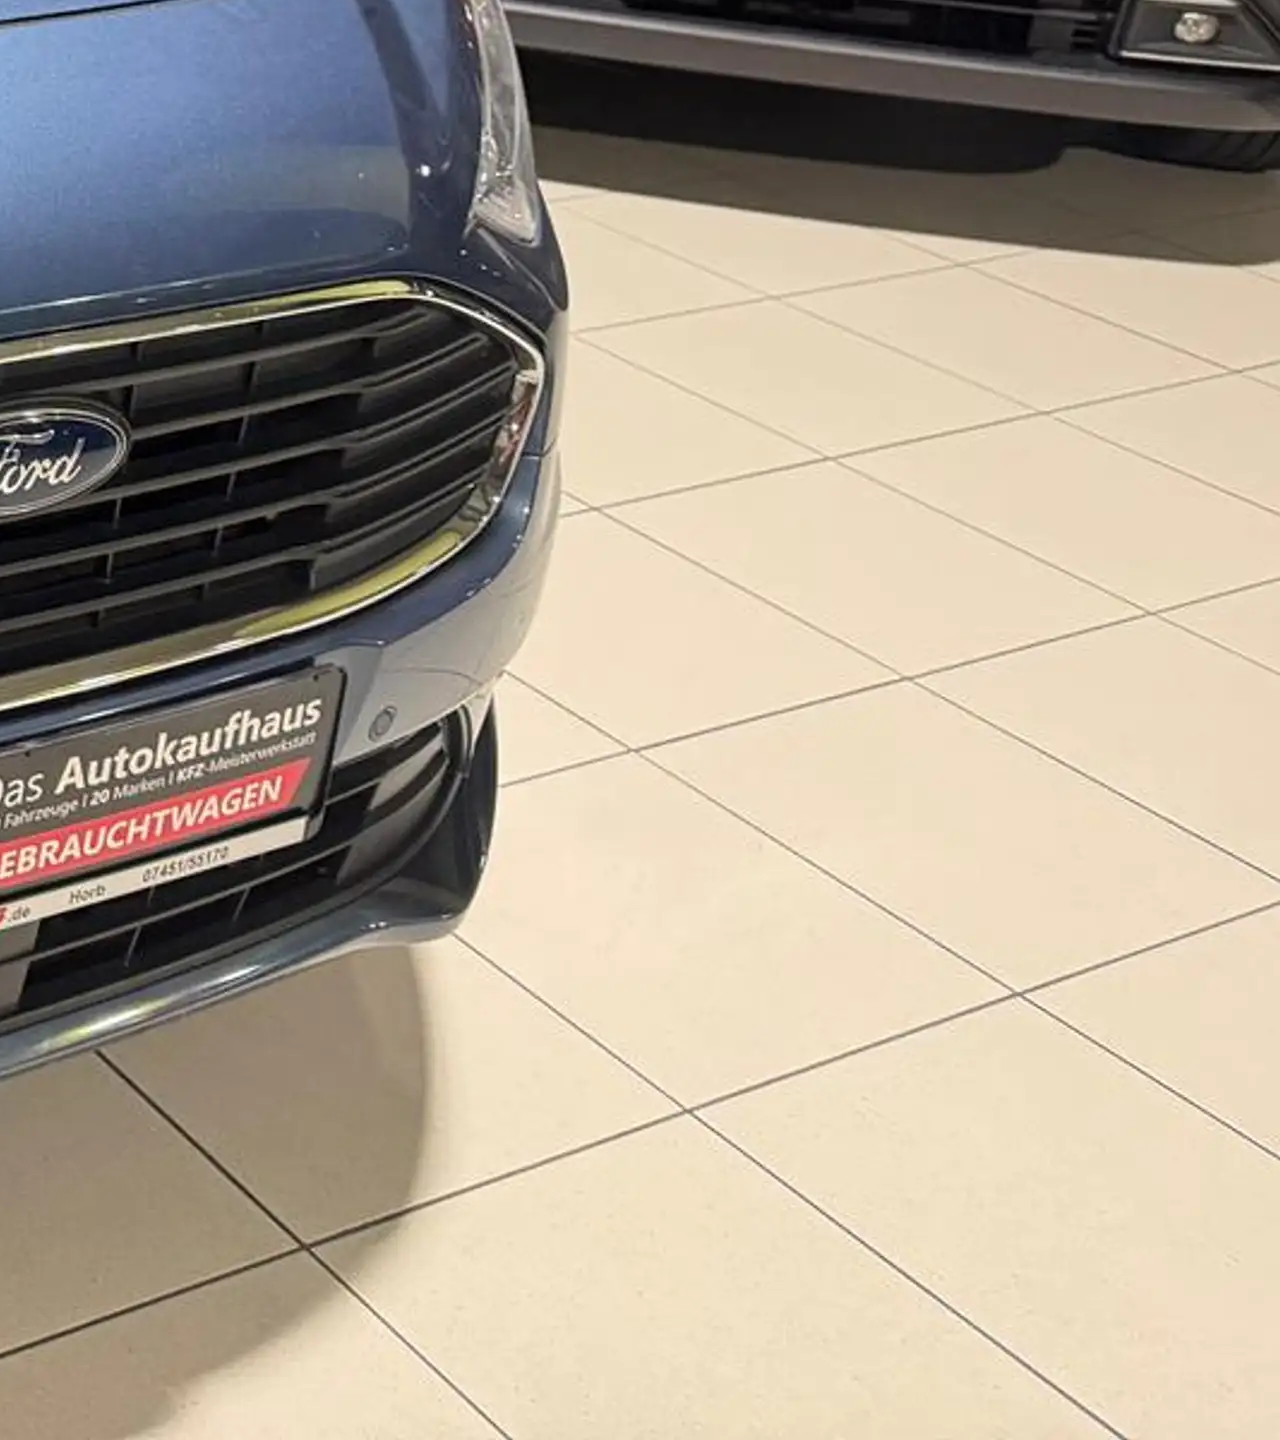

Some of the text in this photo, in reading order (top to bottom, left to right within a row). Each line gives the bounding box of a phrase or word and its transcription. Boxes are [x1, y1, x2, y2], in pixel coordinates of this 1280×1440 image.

[3, 800, 79, 831] Fahrzeuge
[90, 790, 111, 807] 20
[113, 776, 166, 801] Marken
[176, 731, 317, 785] KFZ-Meisterwerkstatt
[54, 698, 323, 795] Autokaufhaus
[68, 884, 107, 905] Horb
